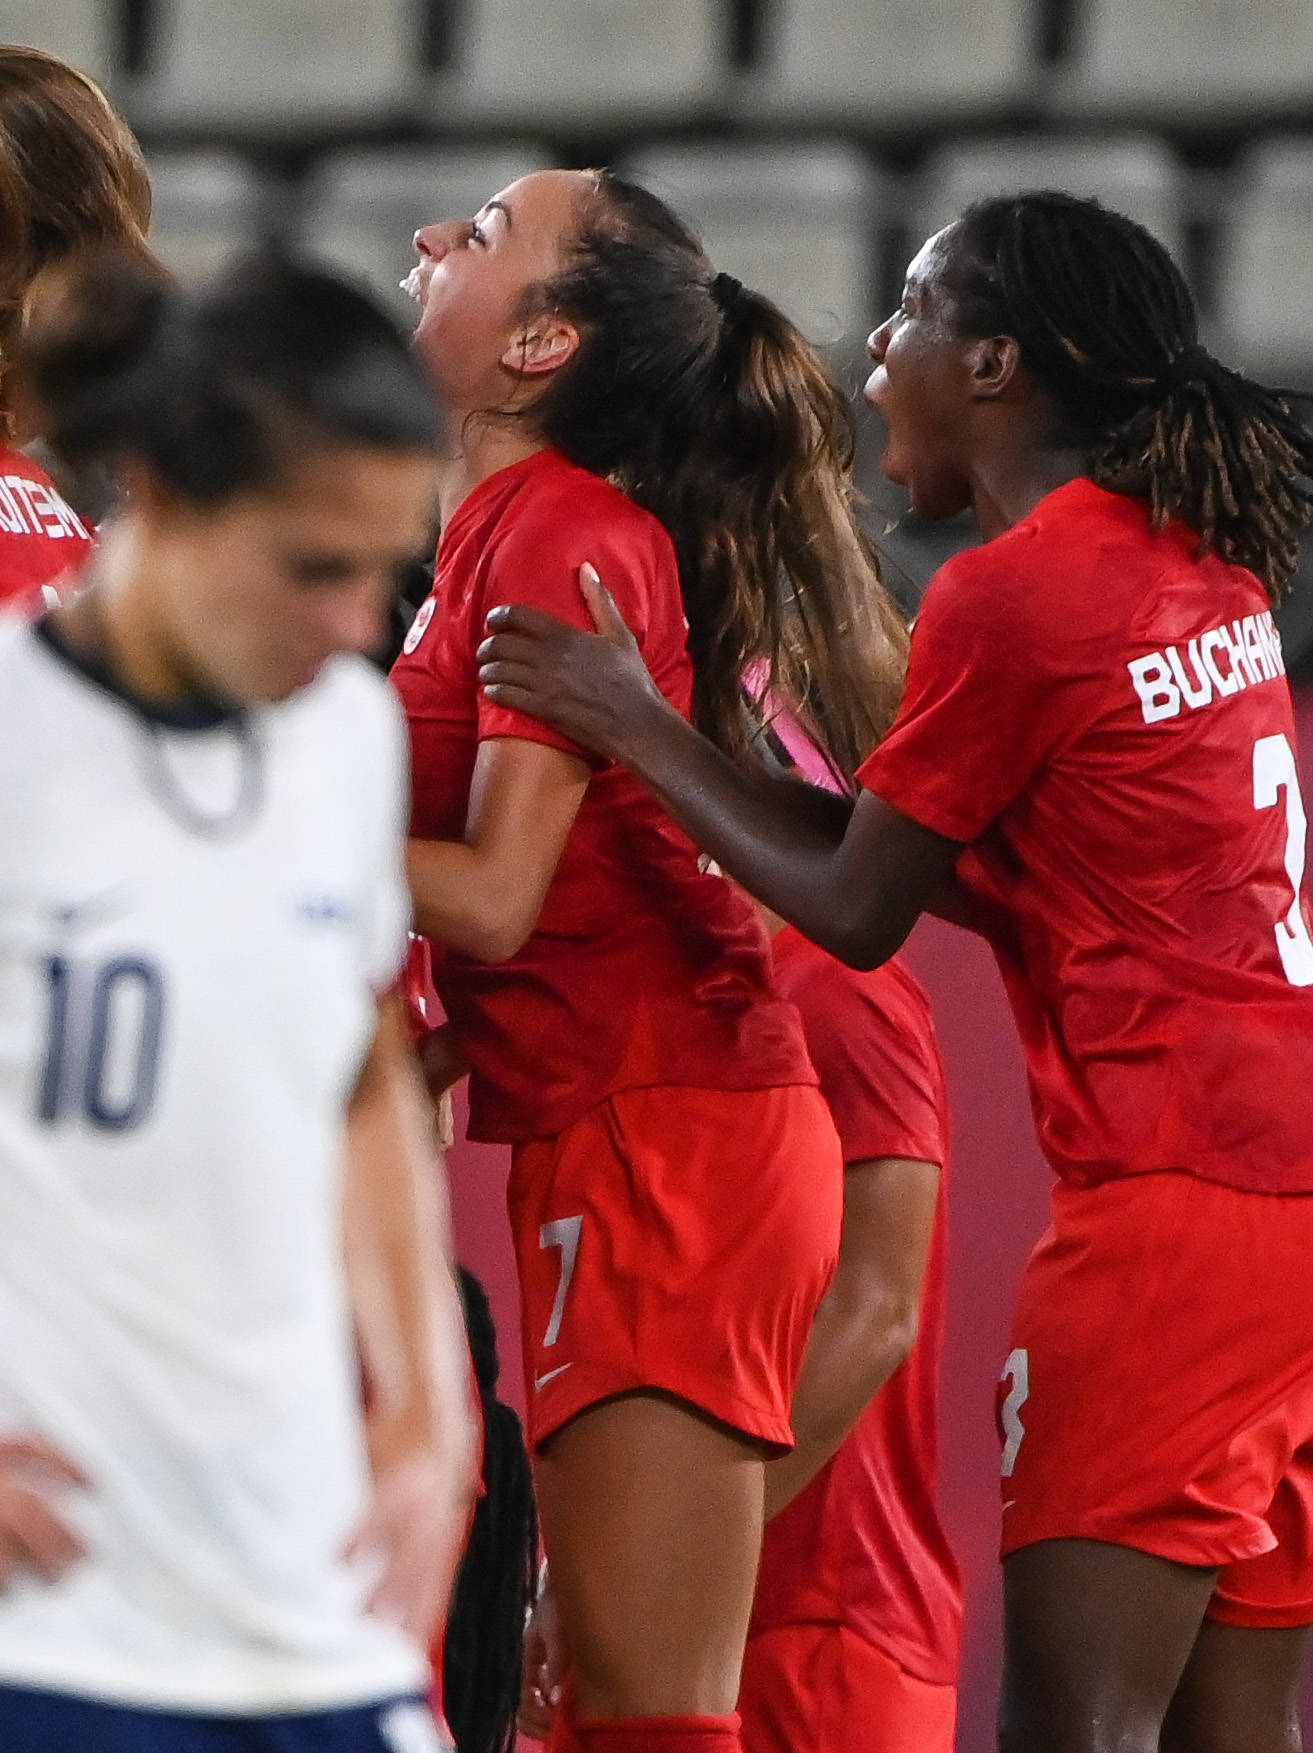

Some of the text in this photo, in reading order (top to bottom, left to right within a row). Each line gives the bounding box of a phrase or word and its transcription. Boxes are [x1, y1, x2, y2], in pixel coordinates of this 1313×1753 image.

[1253, 733, 1313, 987] 3
[40, 955, 166, 1132] 10
[539, 1215, 583, 1347] 7
